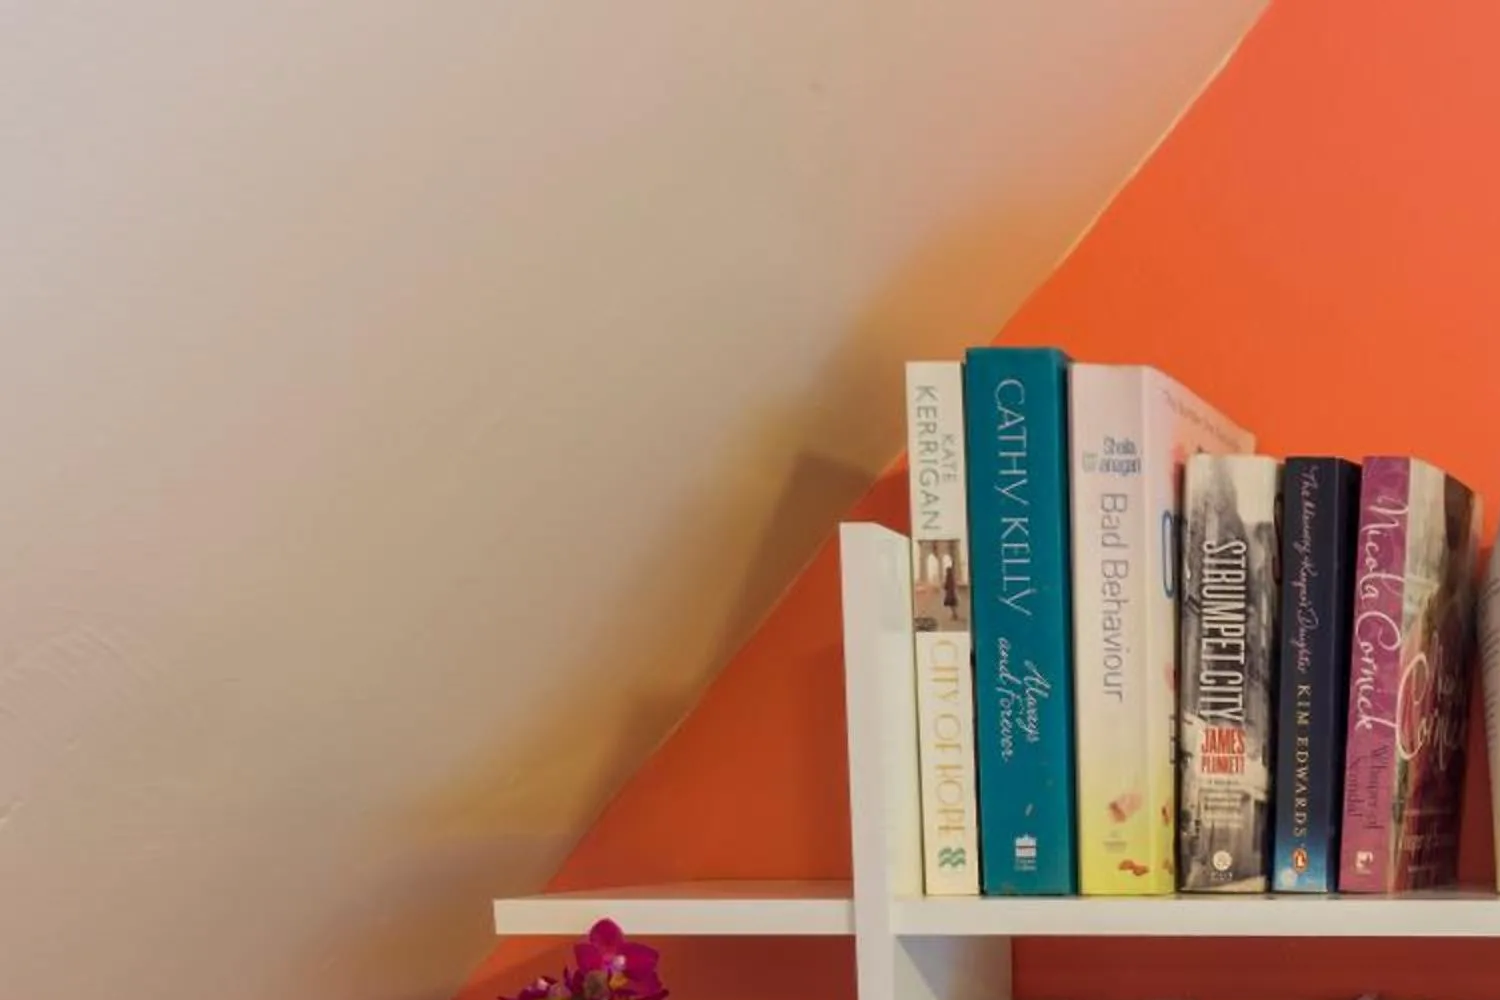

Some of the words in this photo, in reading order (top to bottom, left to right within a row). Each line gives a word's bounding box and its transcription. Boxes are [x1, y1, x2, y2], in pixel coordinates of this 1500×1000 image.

[914, 384, 942, 531] KERRIGAN
[941, 433, 957, 483] KATE
[994, 378, 1030, 507] CATHY
[1299, 464, 1320, 498] The
[998, 517, 1037, 617] KELLY
[1100, 492, 1128, 549] Bad
[1358, 495, 1410, 602] Nicola
[1101, 559, 1131, 704] Behaviour
[1201, 539, 1248, 665] STRUMPET
[1199, 669, 1245, 723] CITY
[1296, 684, 1312, 726] KIM
[1354, 610, 1402, 731] Cornick
[1201, 727, 1246, 754] JAMES
[1293, 736, 1310, 838] EDWARDS
